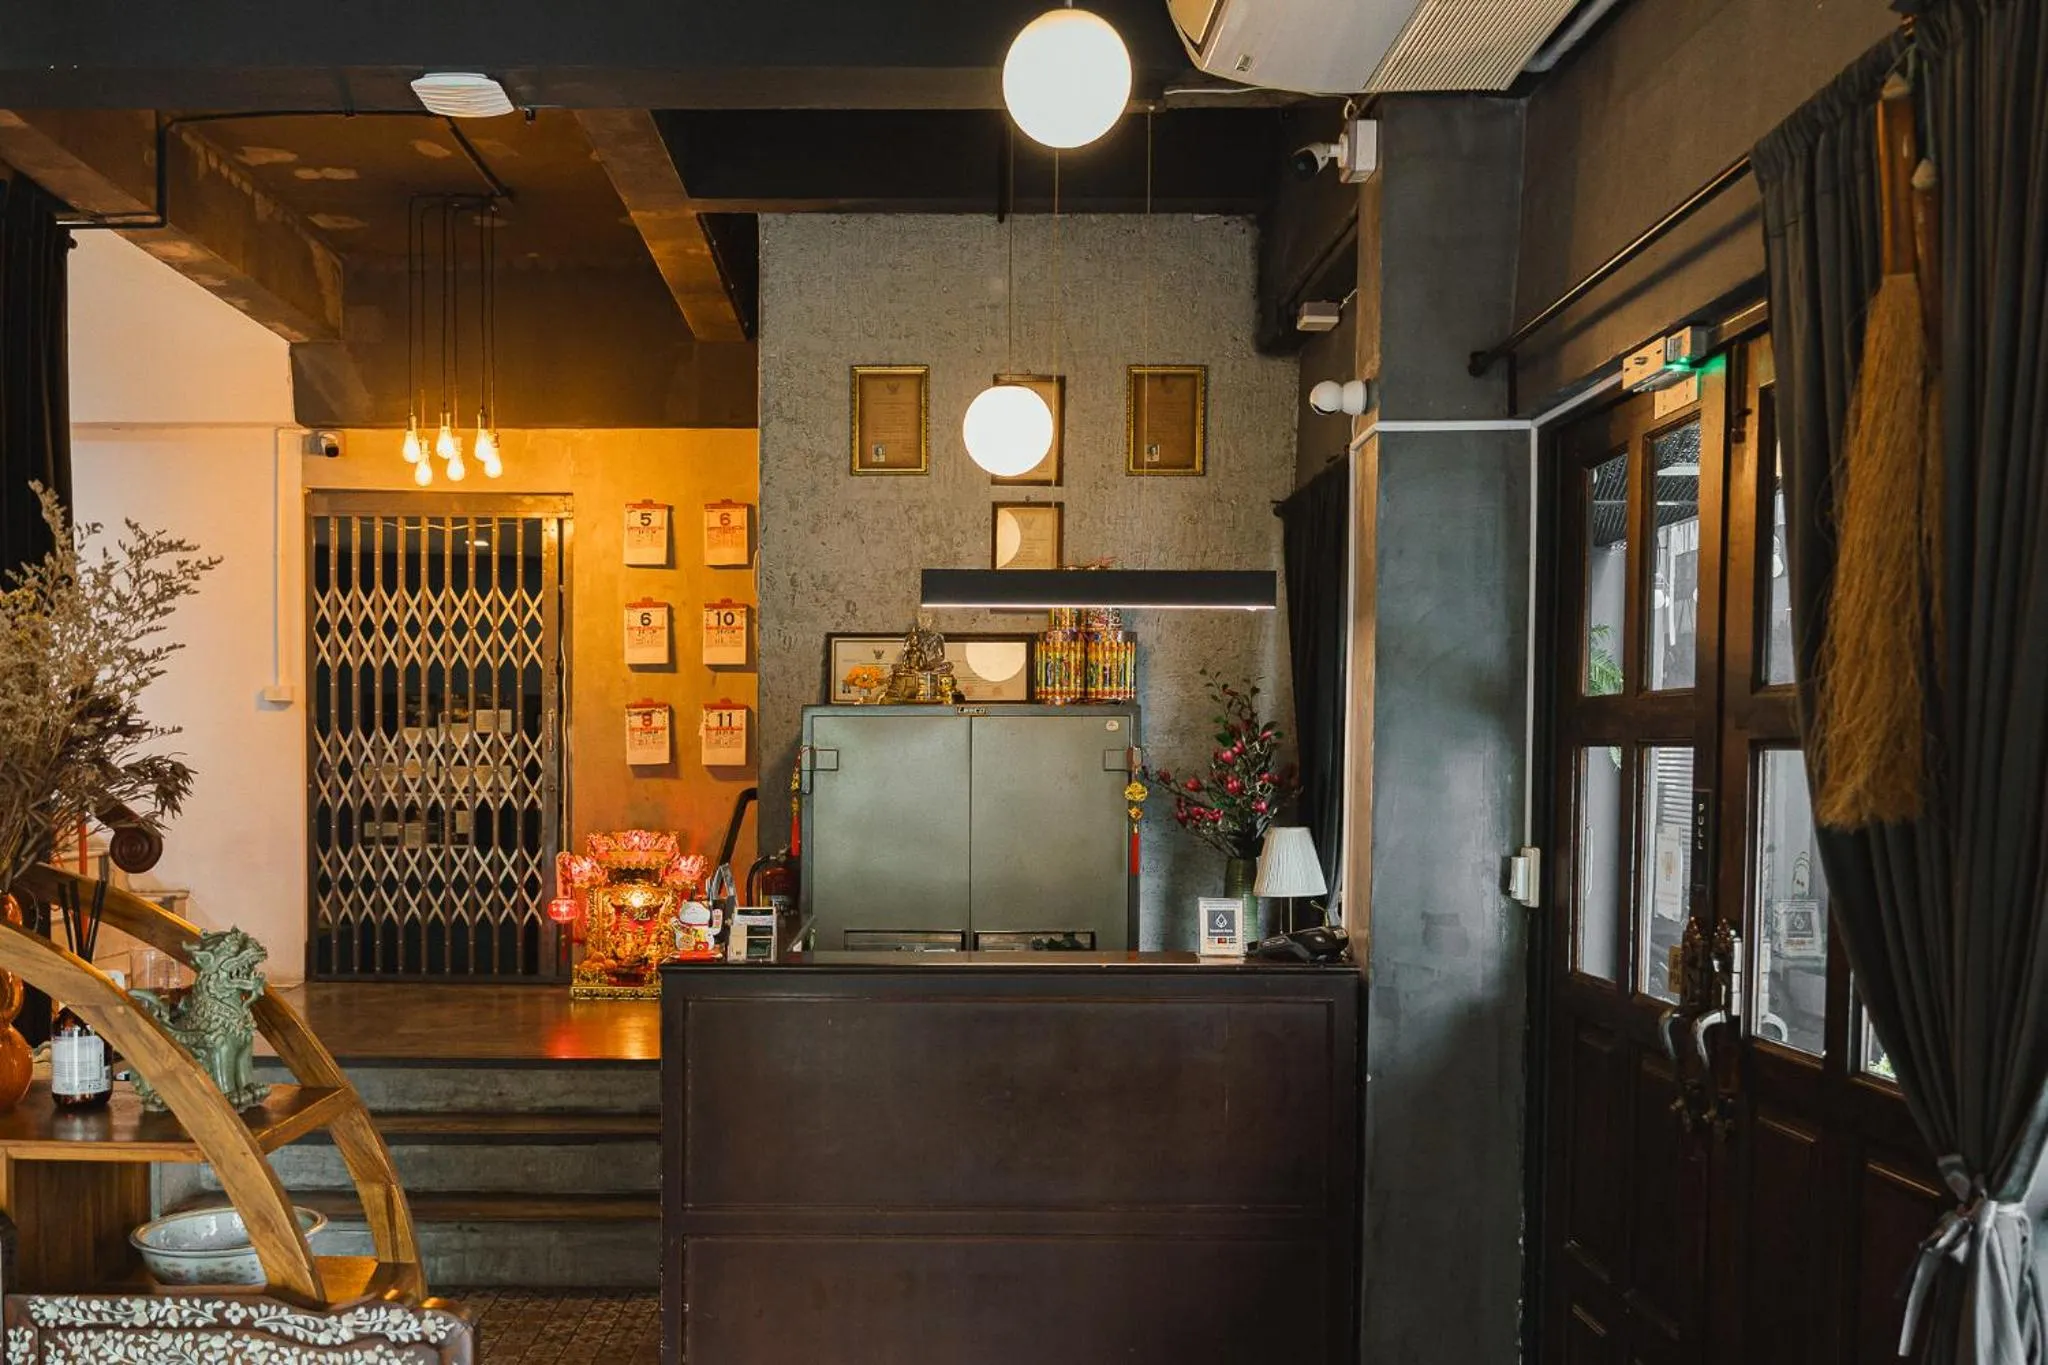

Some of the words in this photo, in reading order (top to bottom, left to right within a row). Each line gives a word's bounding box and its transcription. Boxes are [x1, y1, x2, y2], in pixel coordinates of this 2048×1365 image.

[640, 512, 652, 527] 5
[720, 512, 732, 526] 6
[640, 612, 652, 626] 6
[715, 611, 735, 627] 10
[641, 712, 653, 727] 8
[717, 712, 733, 727] 11
[1697, 802, 1705, 850] PULL
